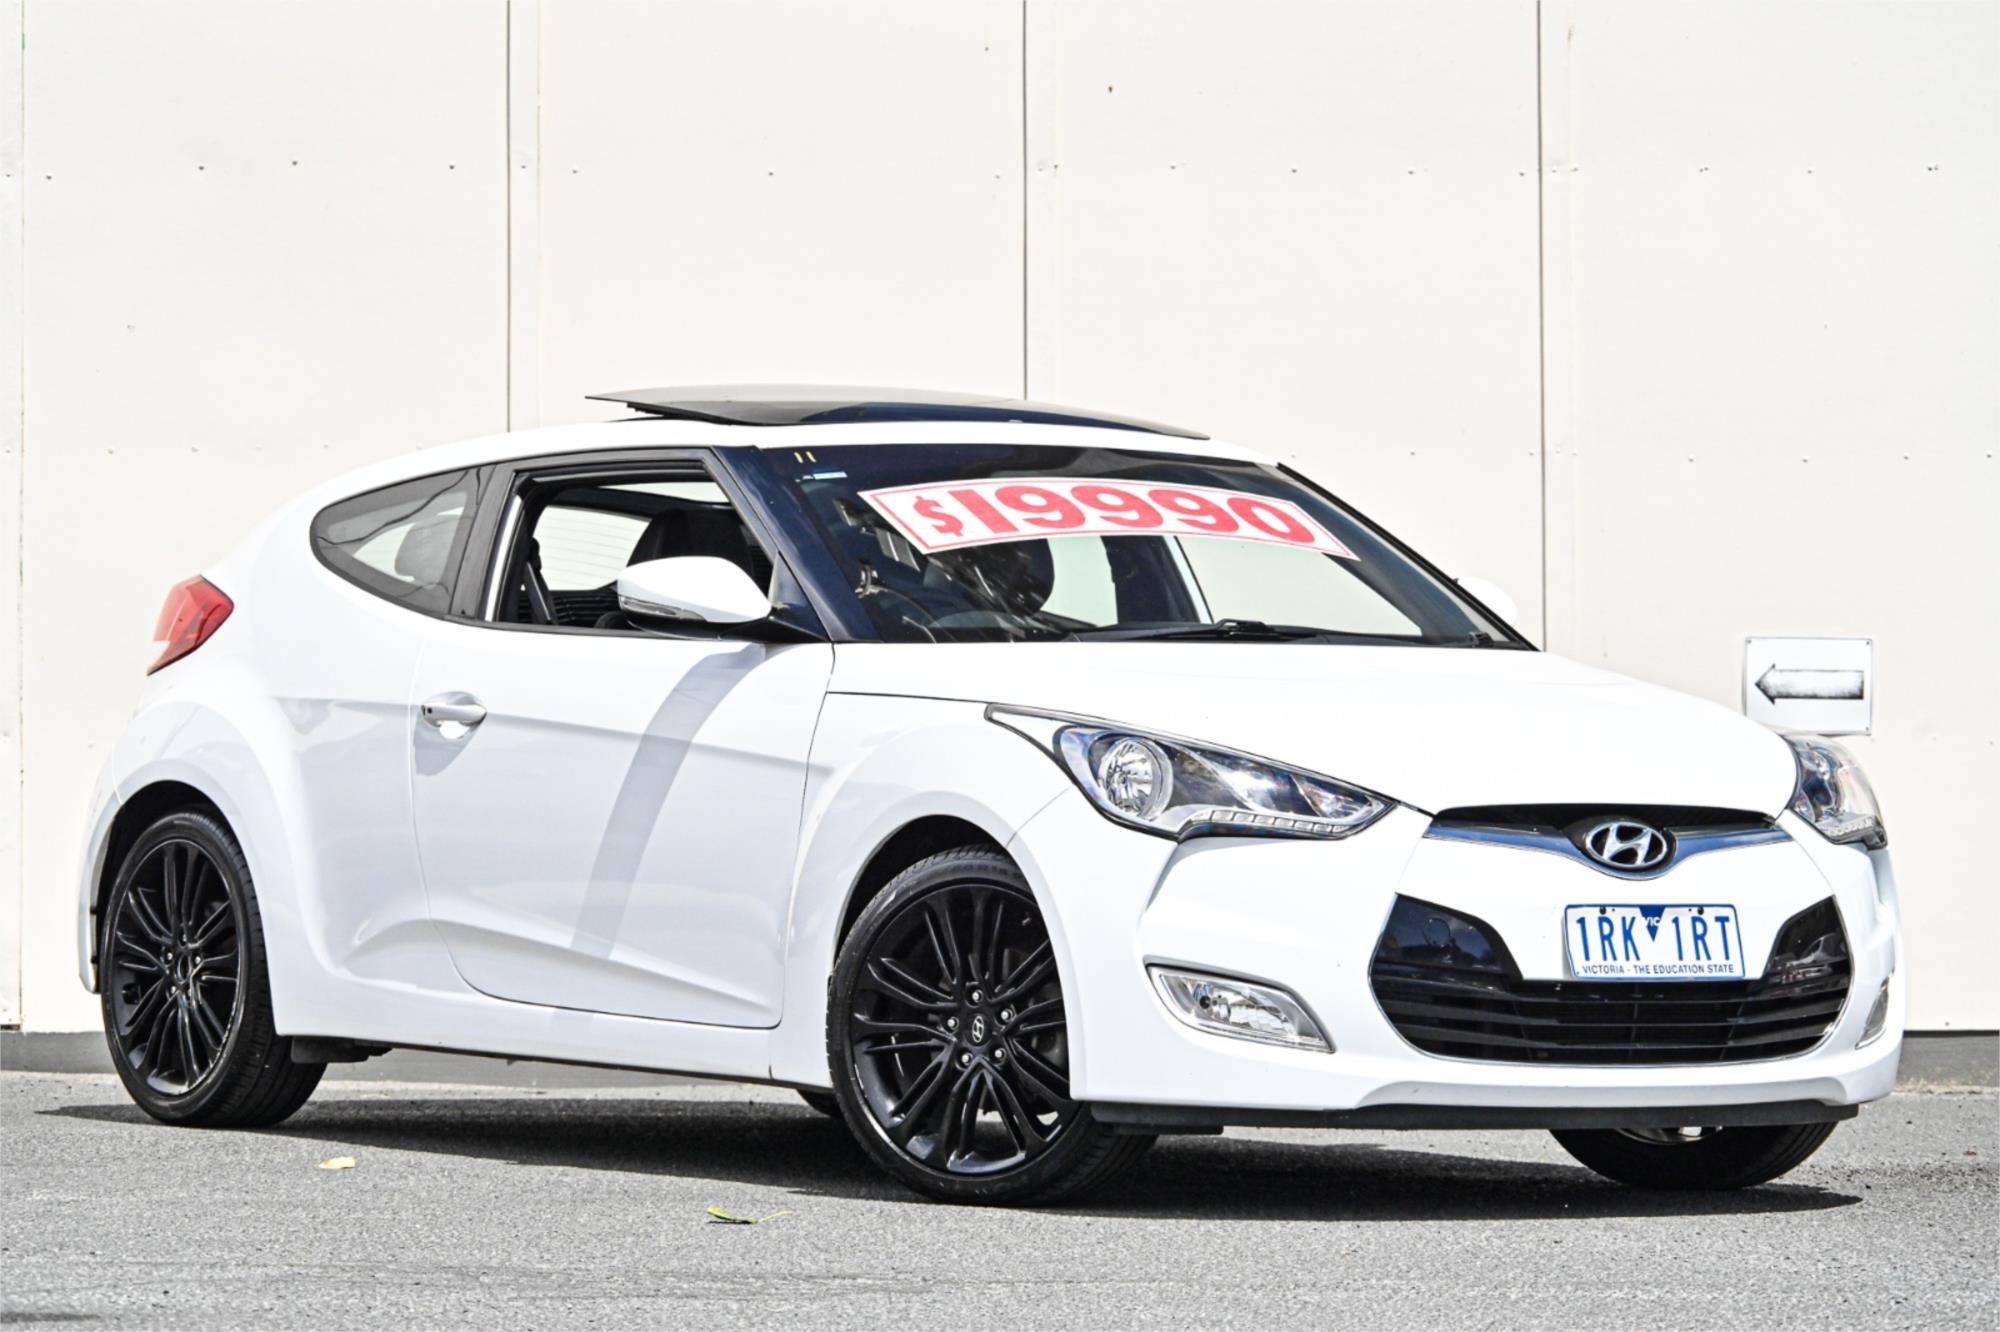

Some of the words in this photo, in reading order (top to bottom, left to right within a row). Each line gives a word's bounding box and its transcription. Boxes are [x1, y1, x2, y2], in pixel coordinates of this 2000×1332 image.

[912, 485, 1316, 544] $19990
[1645, 917, 1661, 927] VIC
[1577, 916, 1641, 961] 1RK
[1672, 916, 1730, 961] 1RT
[1582, 965, 1624, 975] VICTORIA
[1634, 964, 1651, 974] THE
[1653, 964, 1704, 974] EDUCATION
[1707, 964, 1734, 973] STATE
